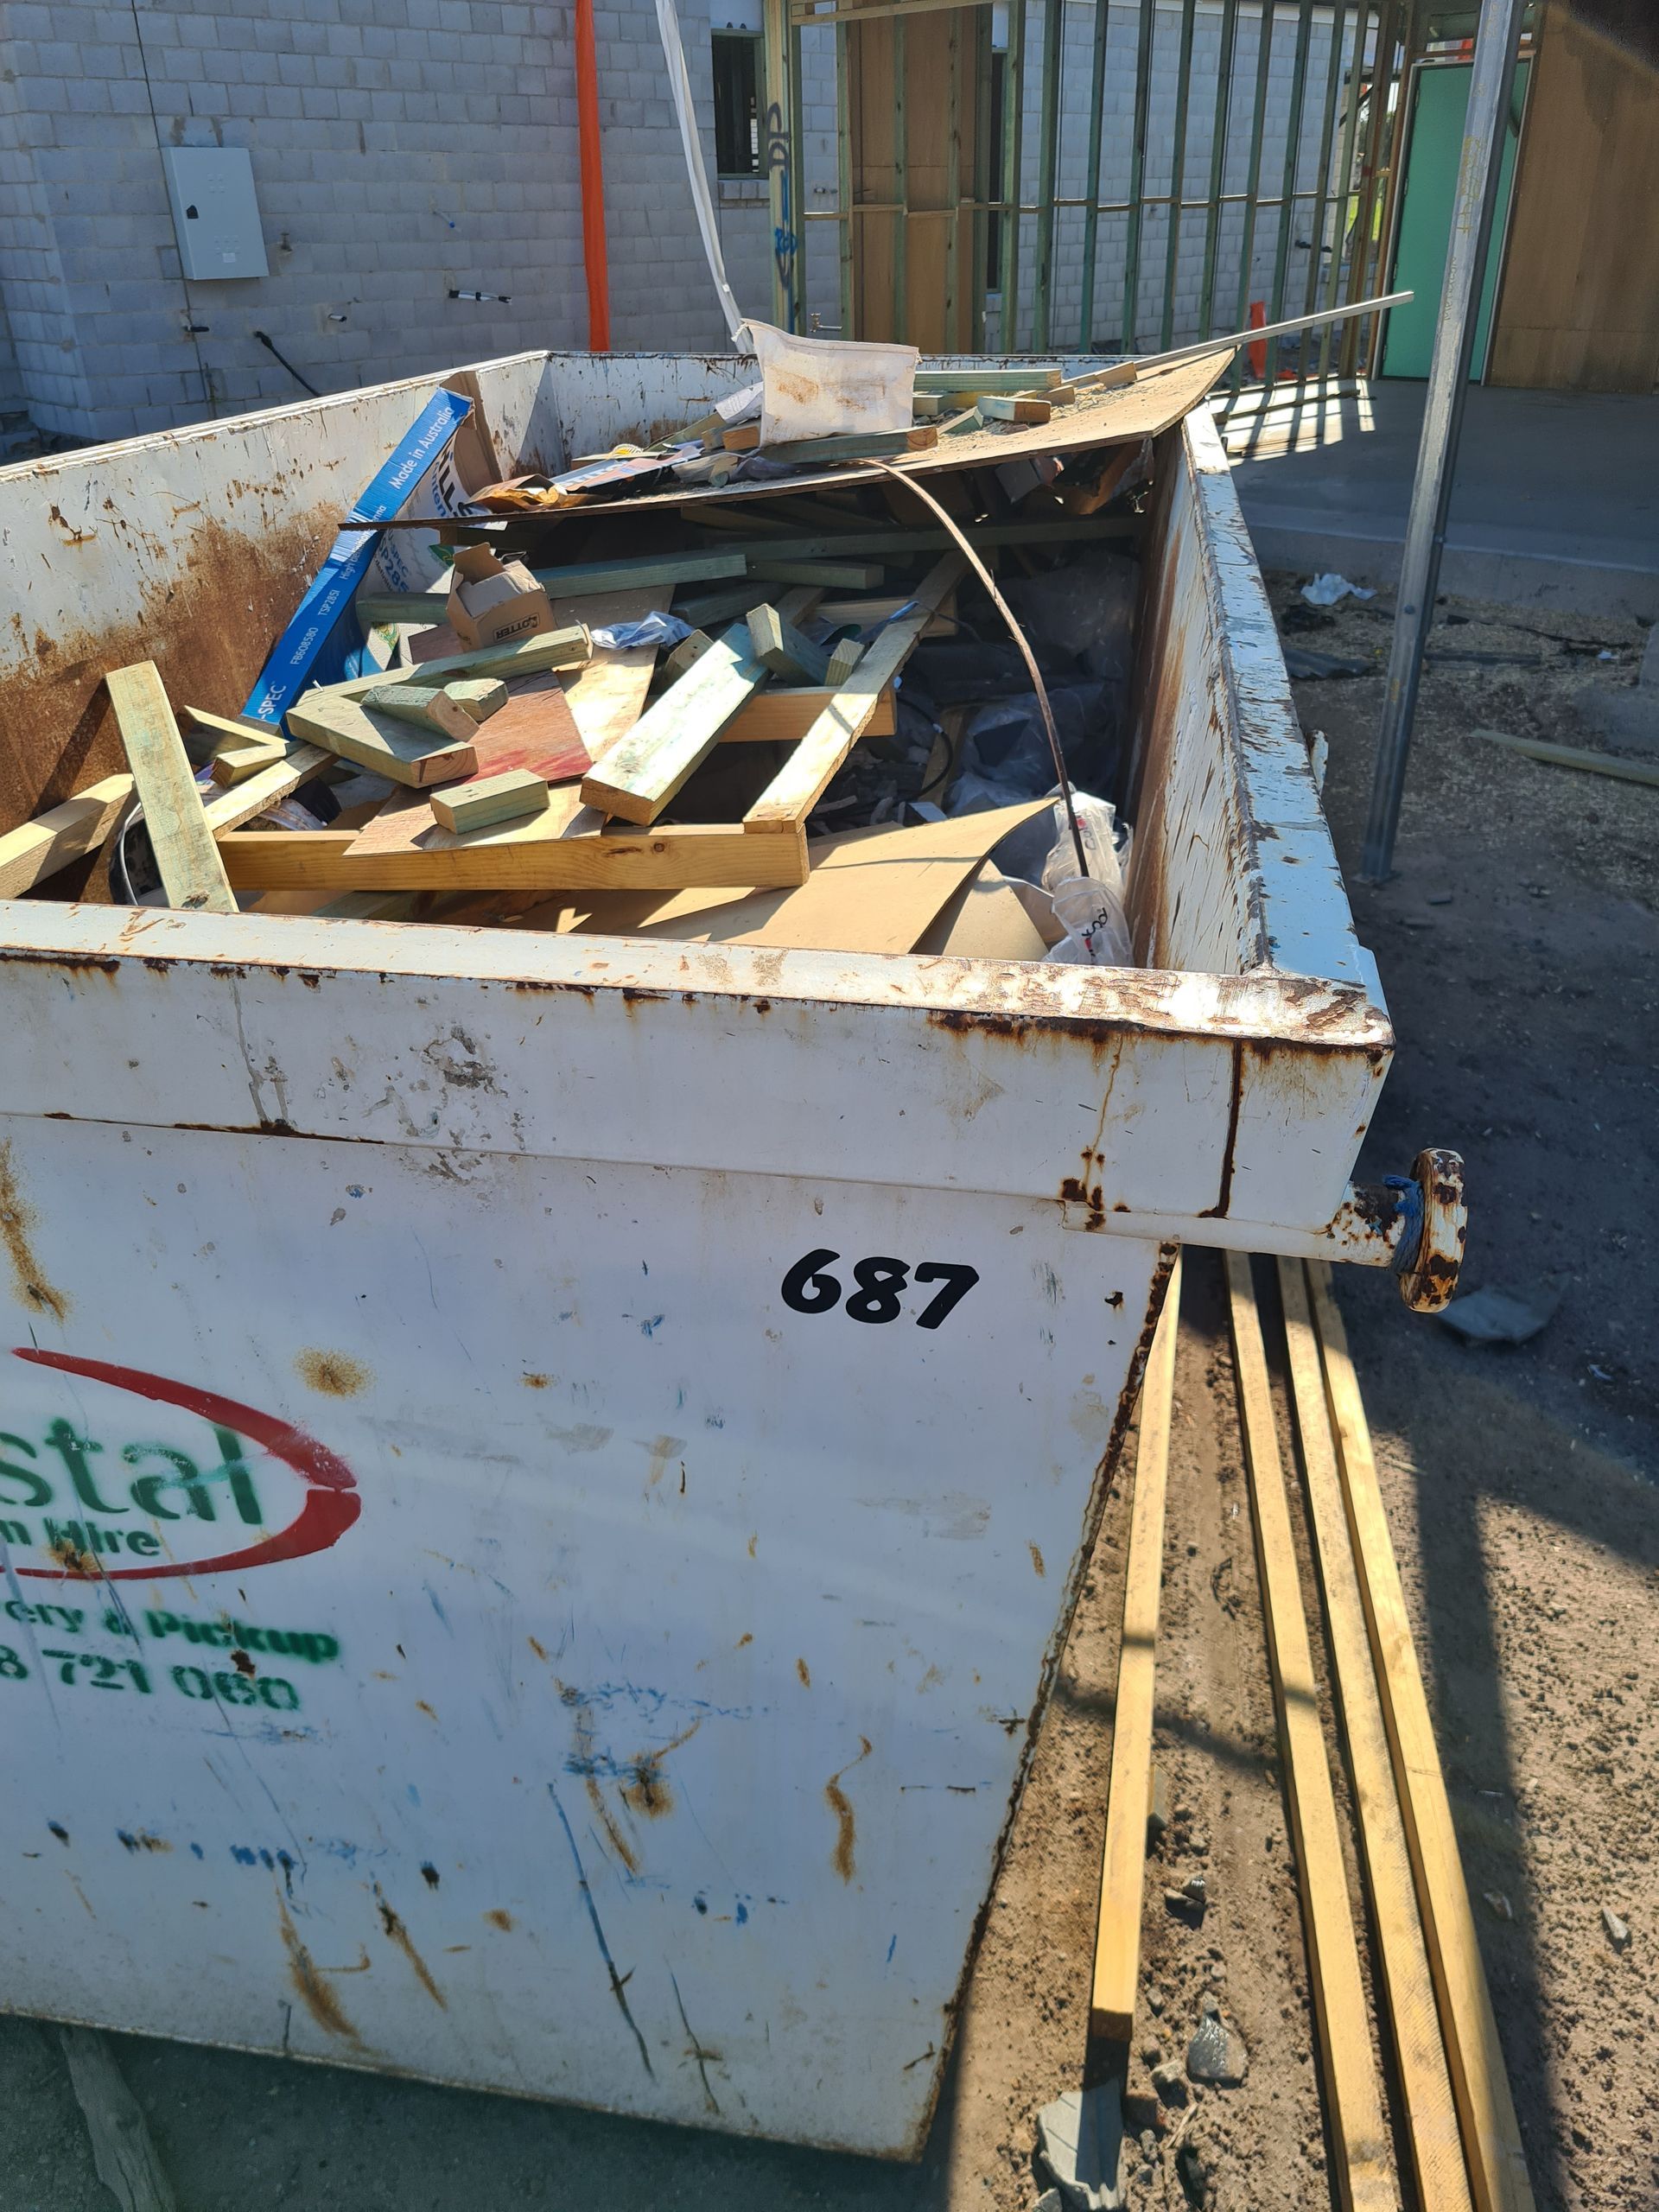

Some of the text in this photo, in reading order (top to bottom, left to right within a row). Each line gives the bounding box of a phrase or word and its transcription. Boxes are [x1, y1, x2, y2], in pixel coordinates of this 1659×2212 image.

[388, 405, 455, 491] Made in Australia
[289, 627, 319, 664] FB608580
[781, 1248, 980, 1330] 687
[43, 1517, 161, 1556] Hire
[144, 1610, 340, 1664] Pickup
[41, 1648, 154, 1695] 721
